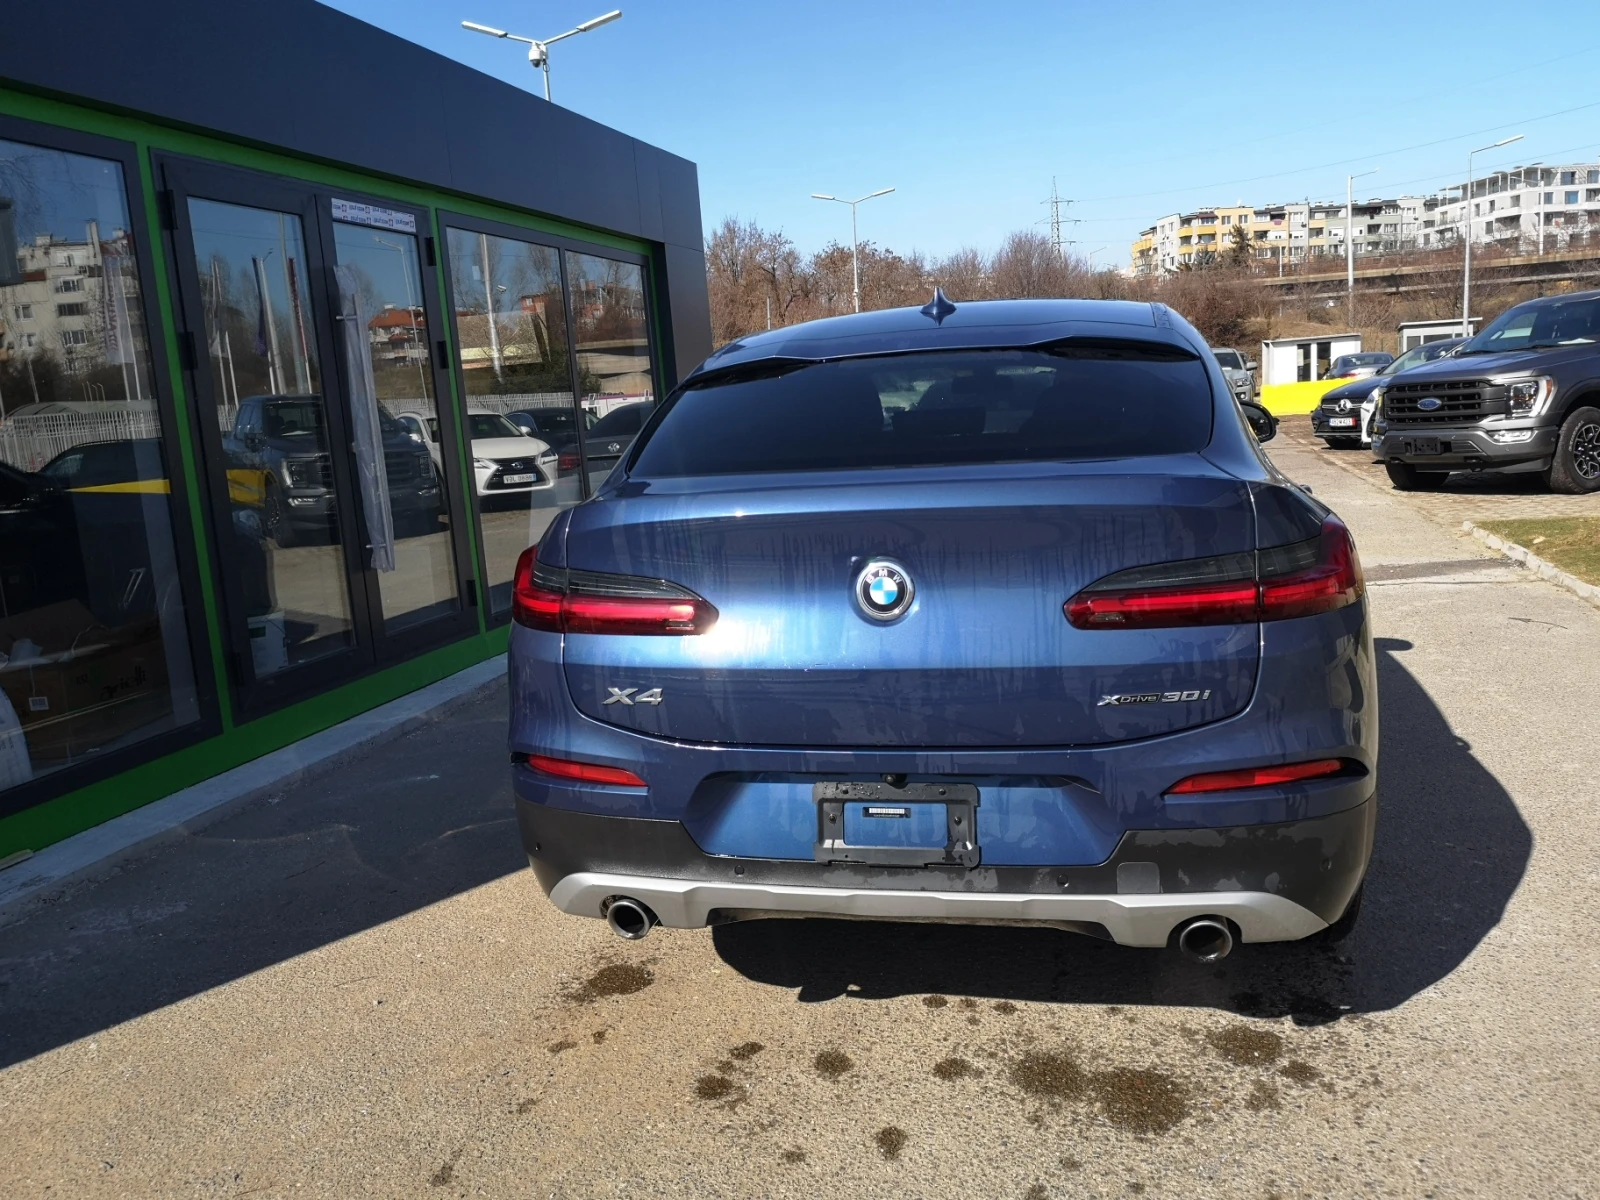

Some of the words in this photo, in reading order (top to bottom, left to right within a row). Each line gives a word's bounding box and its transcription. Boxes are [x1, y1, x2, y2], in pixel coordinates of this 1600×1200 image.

[865, 568, 903, 584] BMW
[602, 687, 663, 705] X4
[1161, 689, 1212, 703] 30i
